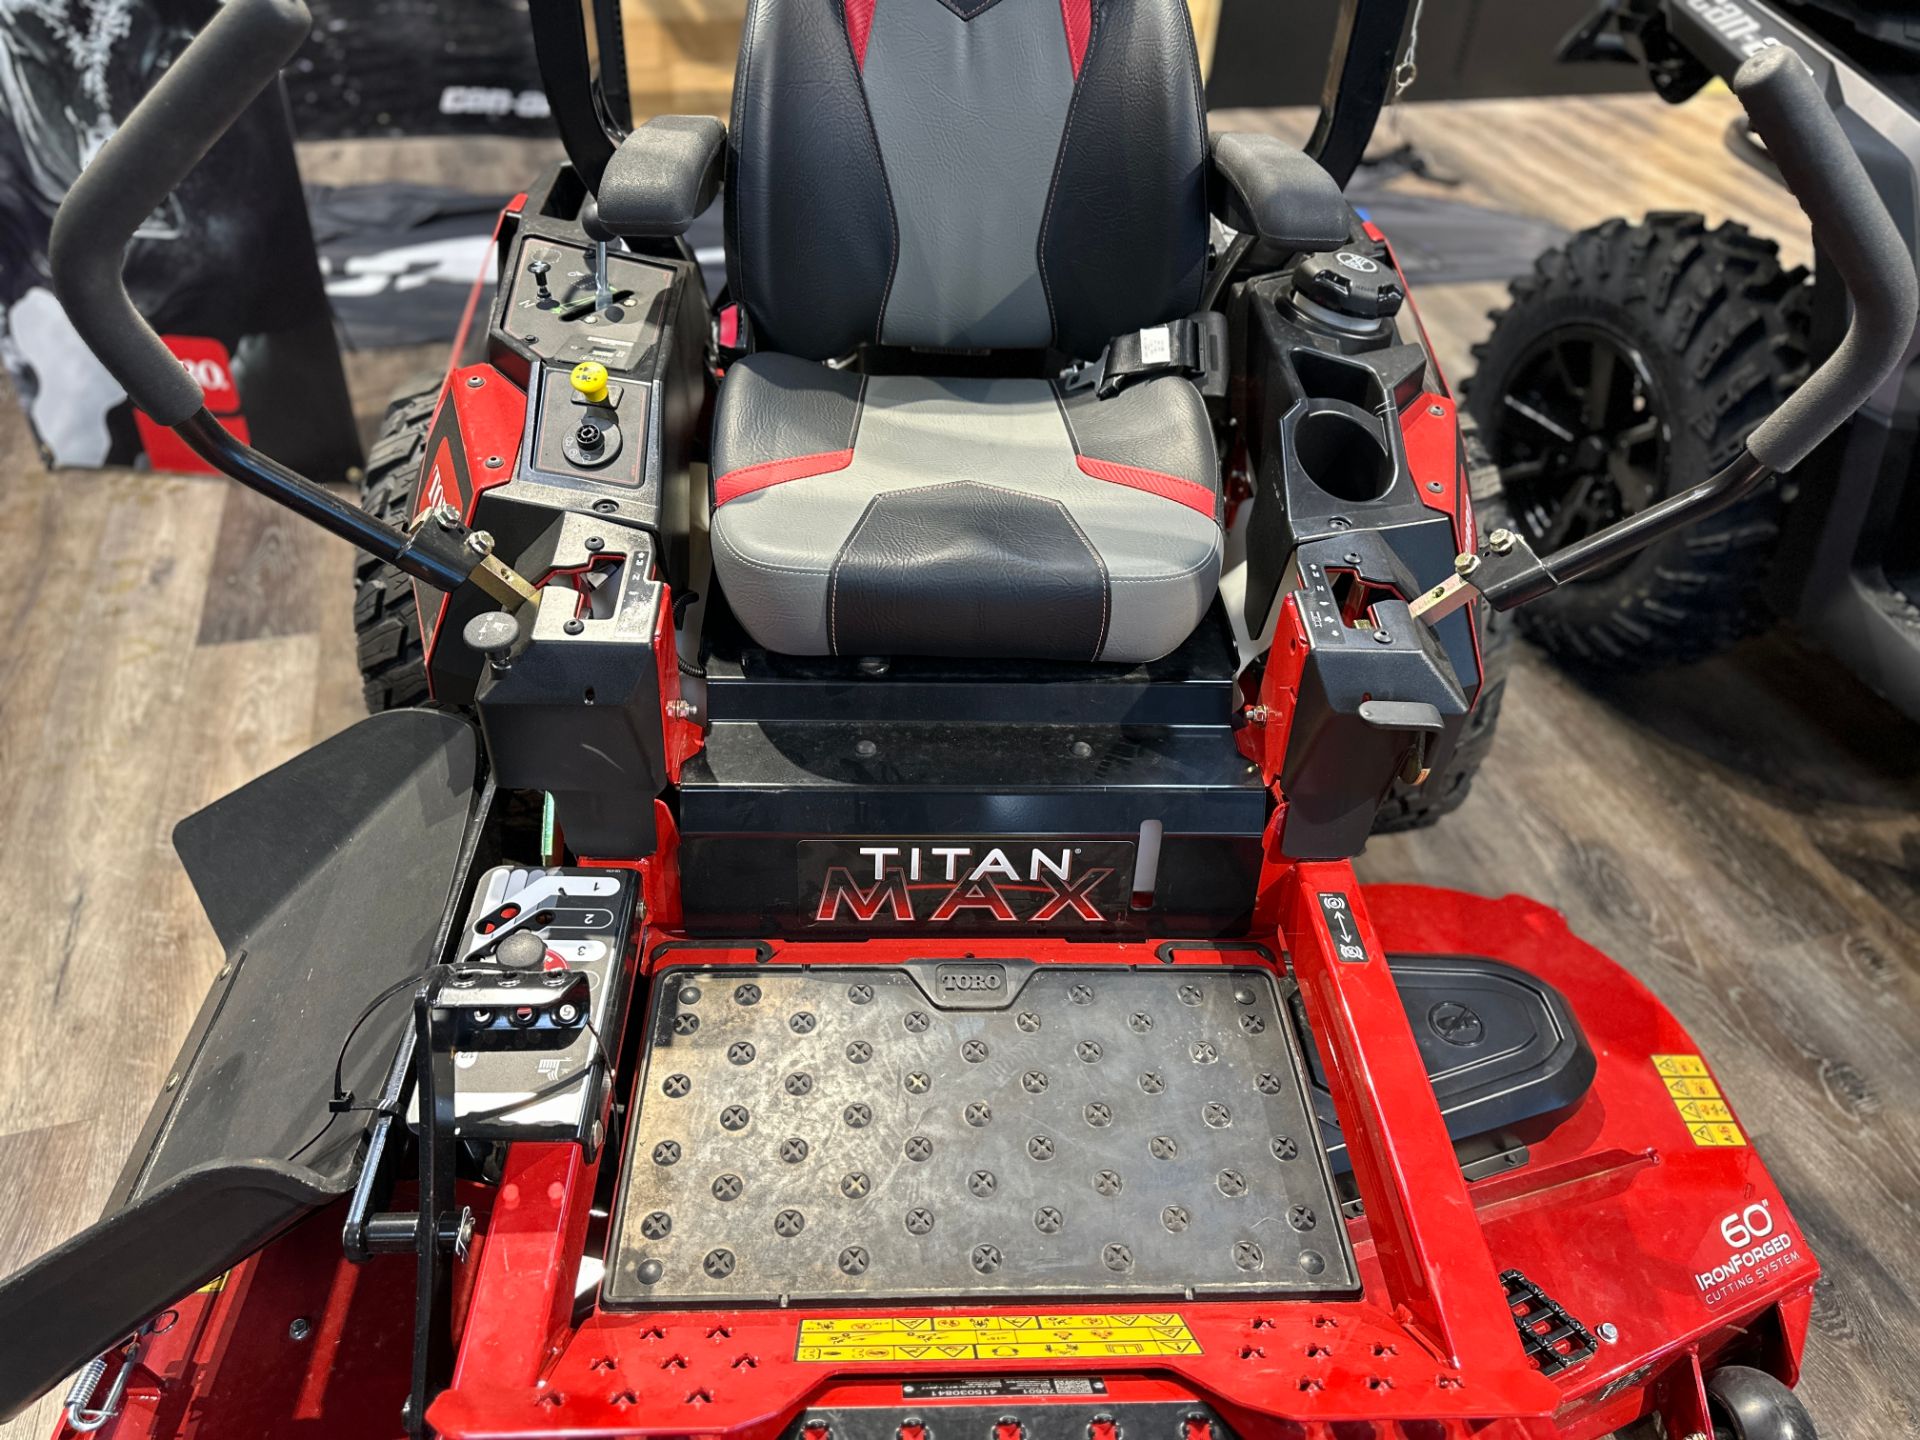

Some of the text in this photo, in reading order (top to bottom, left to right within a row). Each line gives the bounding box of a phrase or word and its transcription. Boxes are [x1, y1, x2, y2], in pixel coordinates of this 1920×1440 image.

[859, 848, 1072, 881] TITAN
[593, 881, 600, 892] 1
[815, 867, 1114, 921] MAX
[584, 913, 595, 924] 2
[578, 945, 587, 956] 3
[942, 974, 1001, 991] TORO
[563, 1004, 573, 1017] 5
[1721, 1199, 1773, 1248] 60"
[1705, 1250, 1800, 1305] CUTTING SYSTEM
